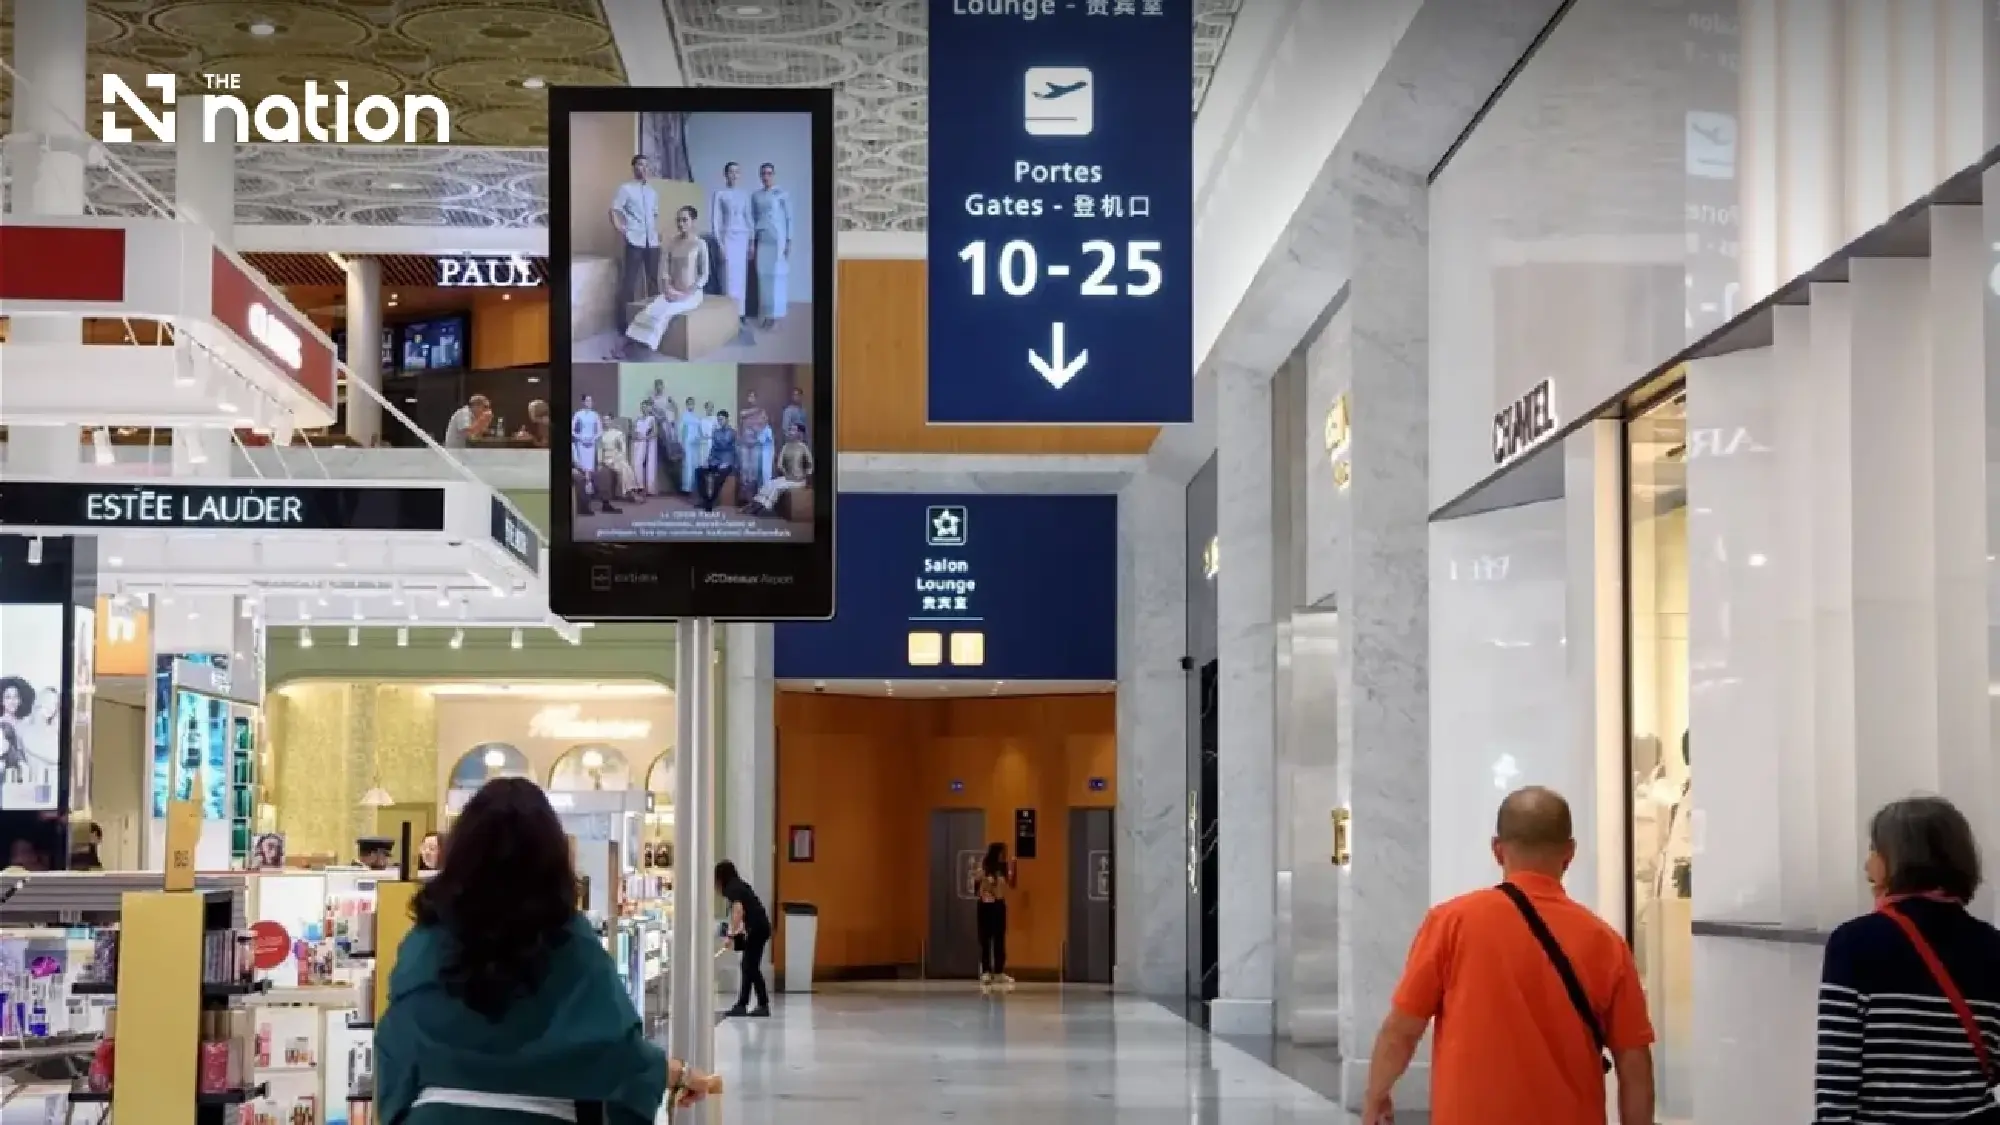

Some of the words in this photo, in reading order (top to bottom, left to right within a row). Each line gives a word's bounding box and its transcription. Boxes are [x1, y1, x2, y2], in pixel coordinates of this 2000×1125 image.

[953, 0, 1055, 20] Lounge
[1015, 159, 1102, 183] Portes
[965, 193, 1043, 216] Gates
[1073, 194, 1150, 218] 登机口
[437, 258, 543, 287] PAUL
[957, 238, 1164, 297] 10-25
[182, 494, 303, 523] LAUDER
[924, 557, 969, 573] Salon
[916, 576, 976, 594] Lounge
